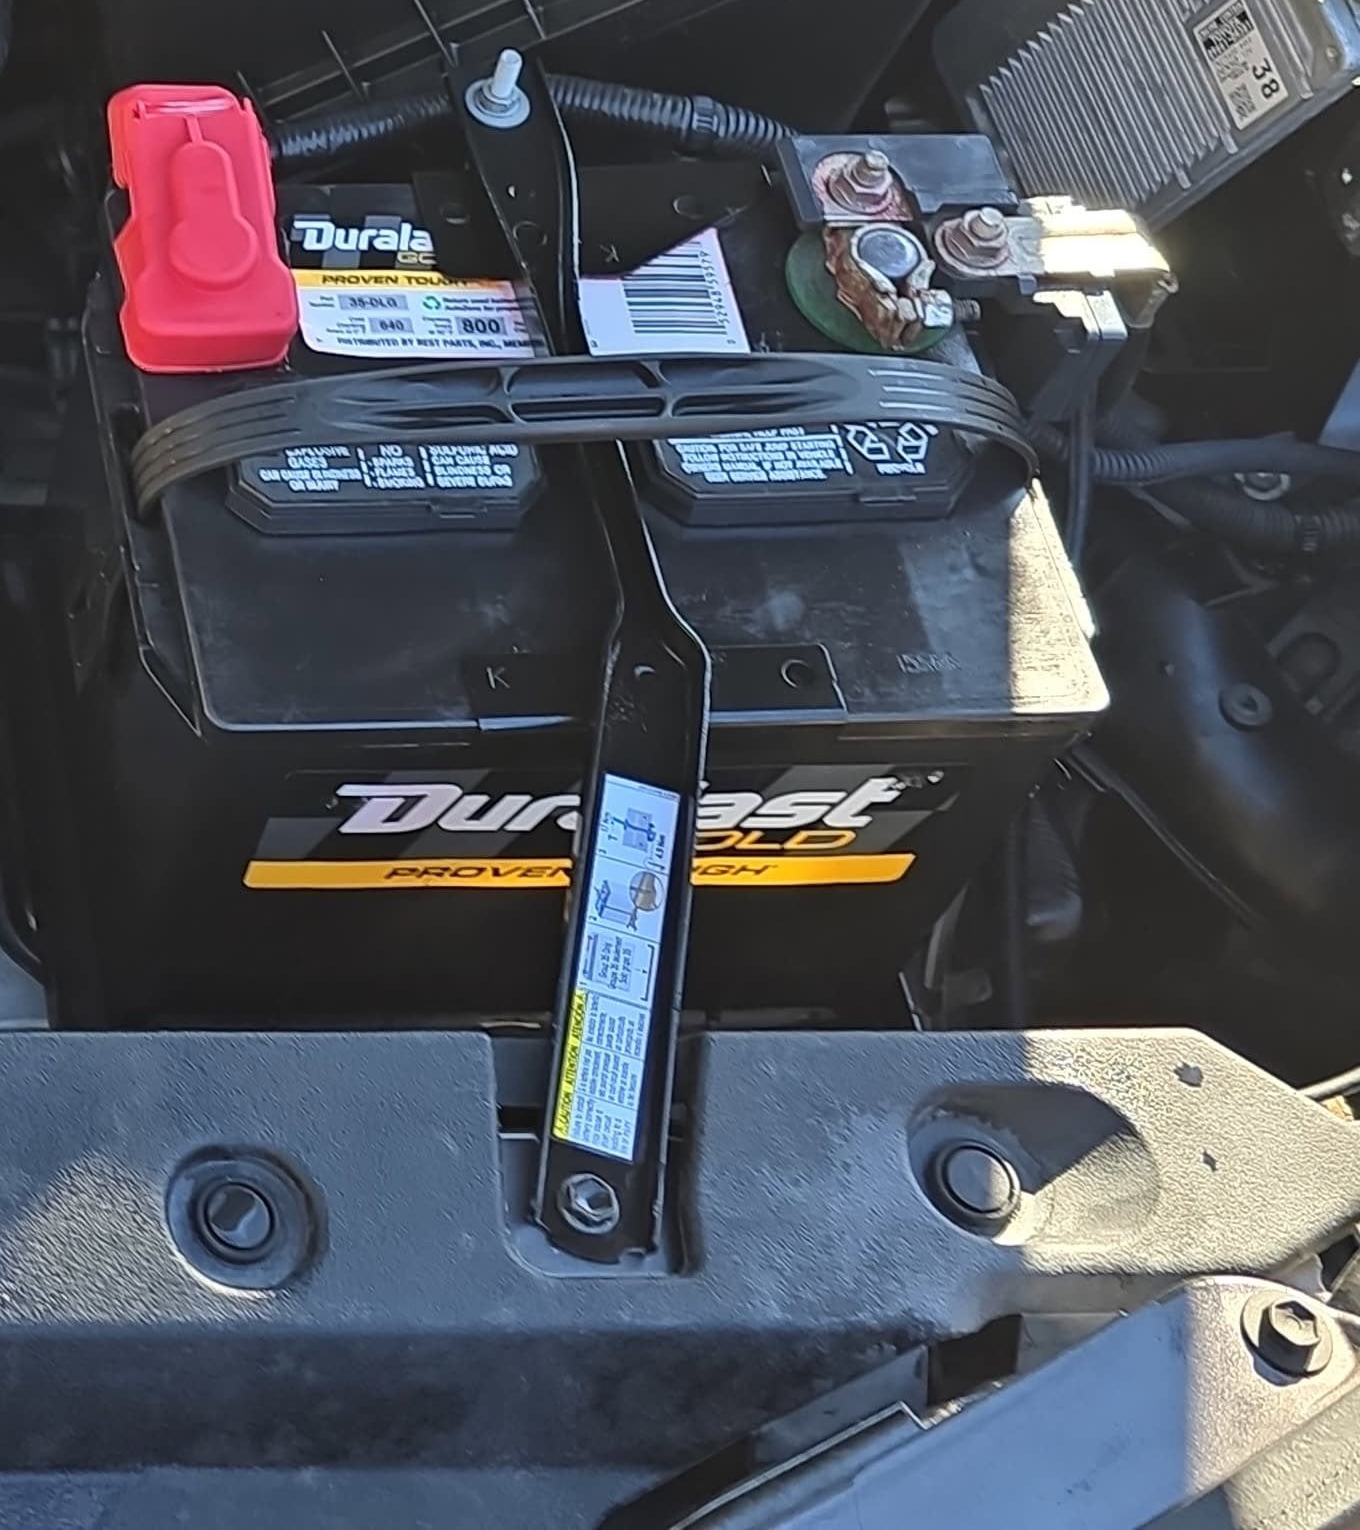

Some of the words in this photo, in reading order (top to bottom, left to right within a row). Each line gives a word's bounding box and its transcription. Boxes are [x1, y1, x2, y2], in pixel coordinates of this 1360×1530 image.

[293, 220, 434, 251] Durala
[322, 274, 399, 285] PROVEN
[461, 318, 501, 334] 800
[336, 337, 400, 347] DISTRIBUTED
[401, 338, 414, 347] BY
[416, 338, 440, 347] BEST
[380, 444, 403, 456] NO
[488, 444, 519, 456] ACID
[431, 455, 454, 465] CAN
[336, 777, 901, 832] Durast
[694, 830, 857, 851] OLD
[558, 1090, 572, 1124] CAUTION
